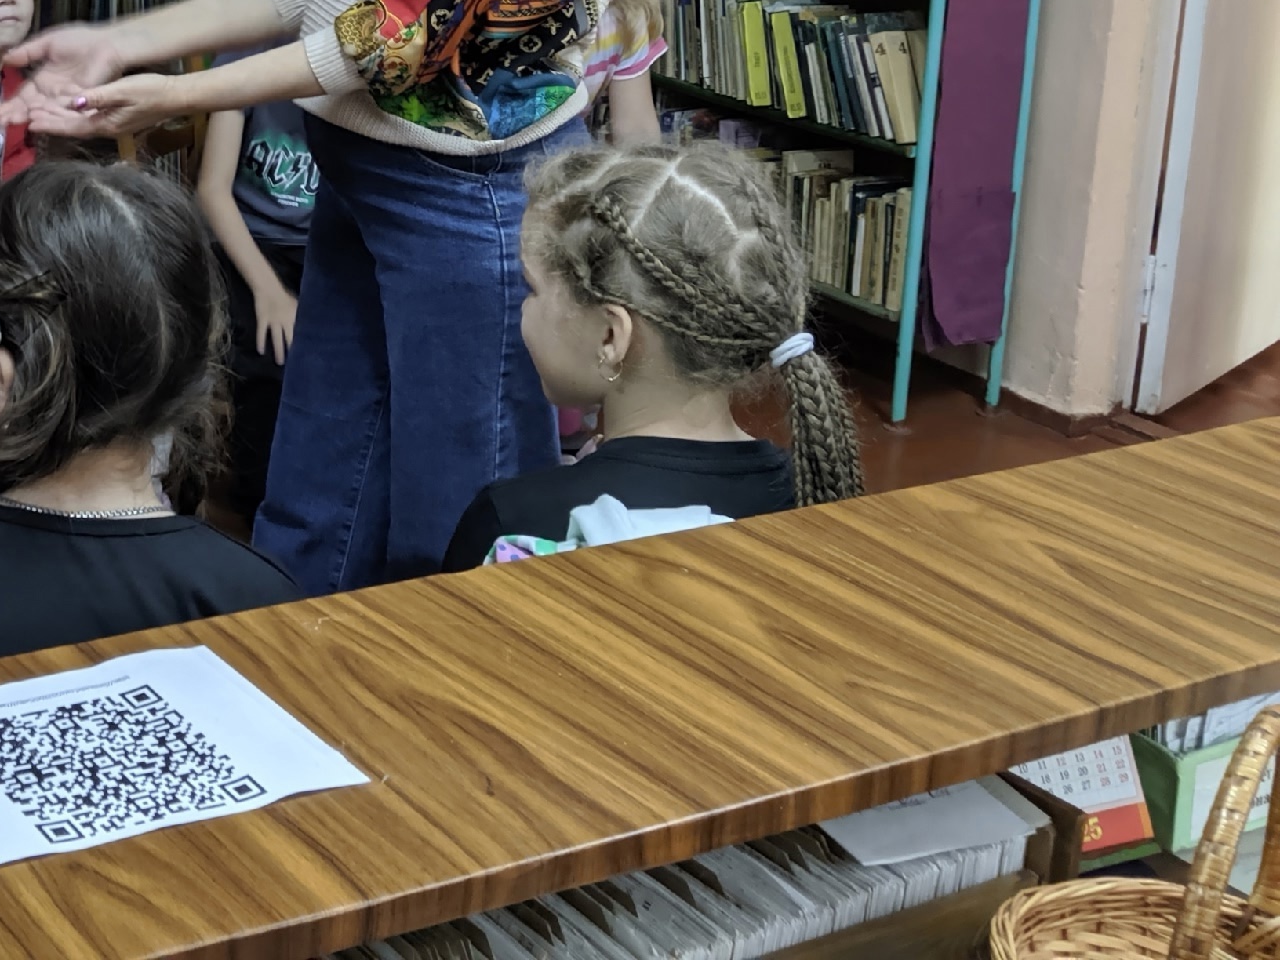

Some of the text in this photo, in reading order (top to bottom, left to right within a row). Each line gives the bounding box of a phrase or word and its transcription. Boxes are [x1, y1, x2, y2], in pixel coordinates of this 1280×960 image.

[875, 43, 887, 56] 4
[898, 42, 908, 55] 4
[1038, 761, 1048, 770] 11
[1056, 757, 1067, 767] 12
[1075, 753, 1085, 763] 13
[1093, 749, 1104, 759] 14
[1112, 746, 1123, 756] 15
[1041, 760, 1126, 784] 18 19 20 21 22
[1063, 773, 1129, 795] 26 27 28 29
